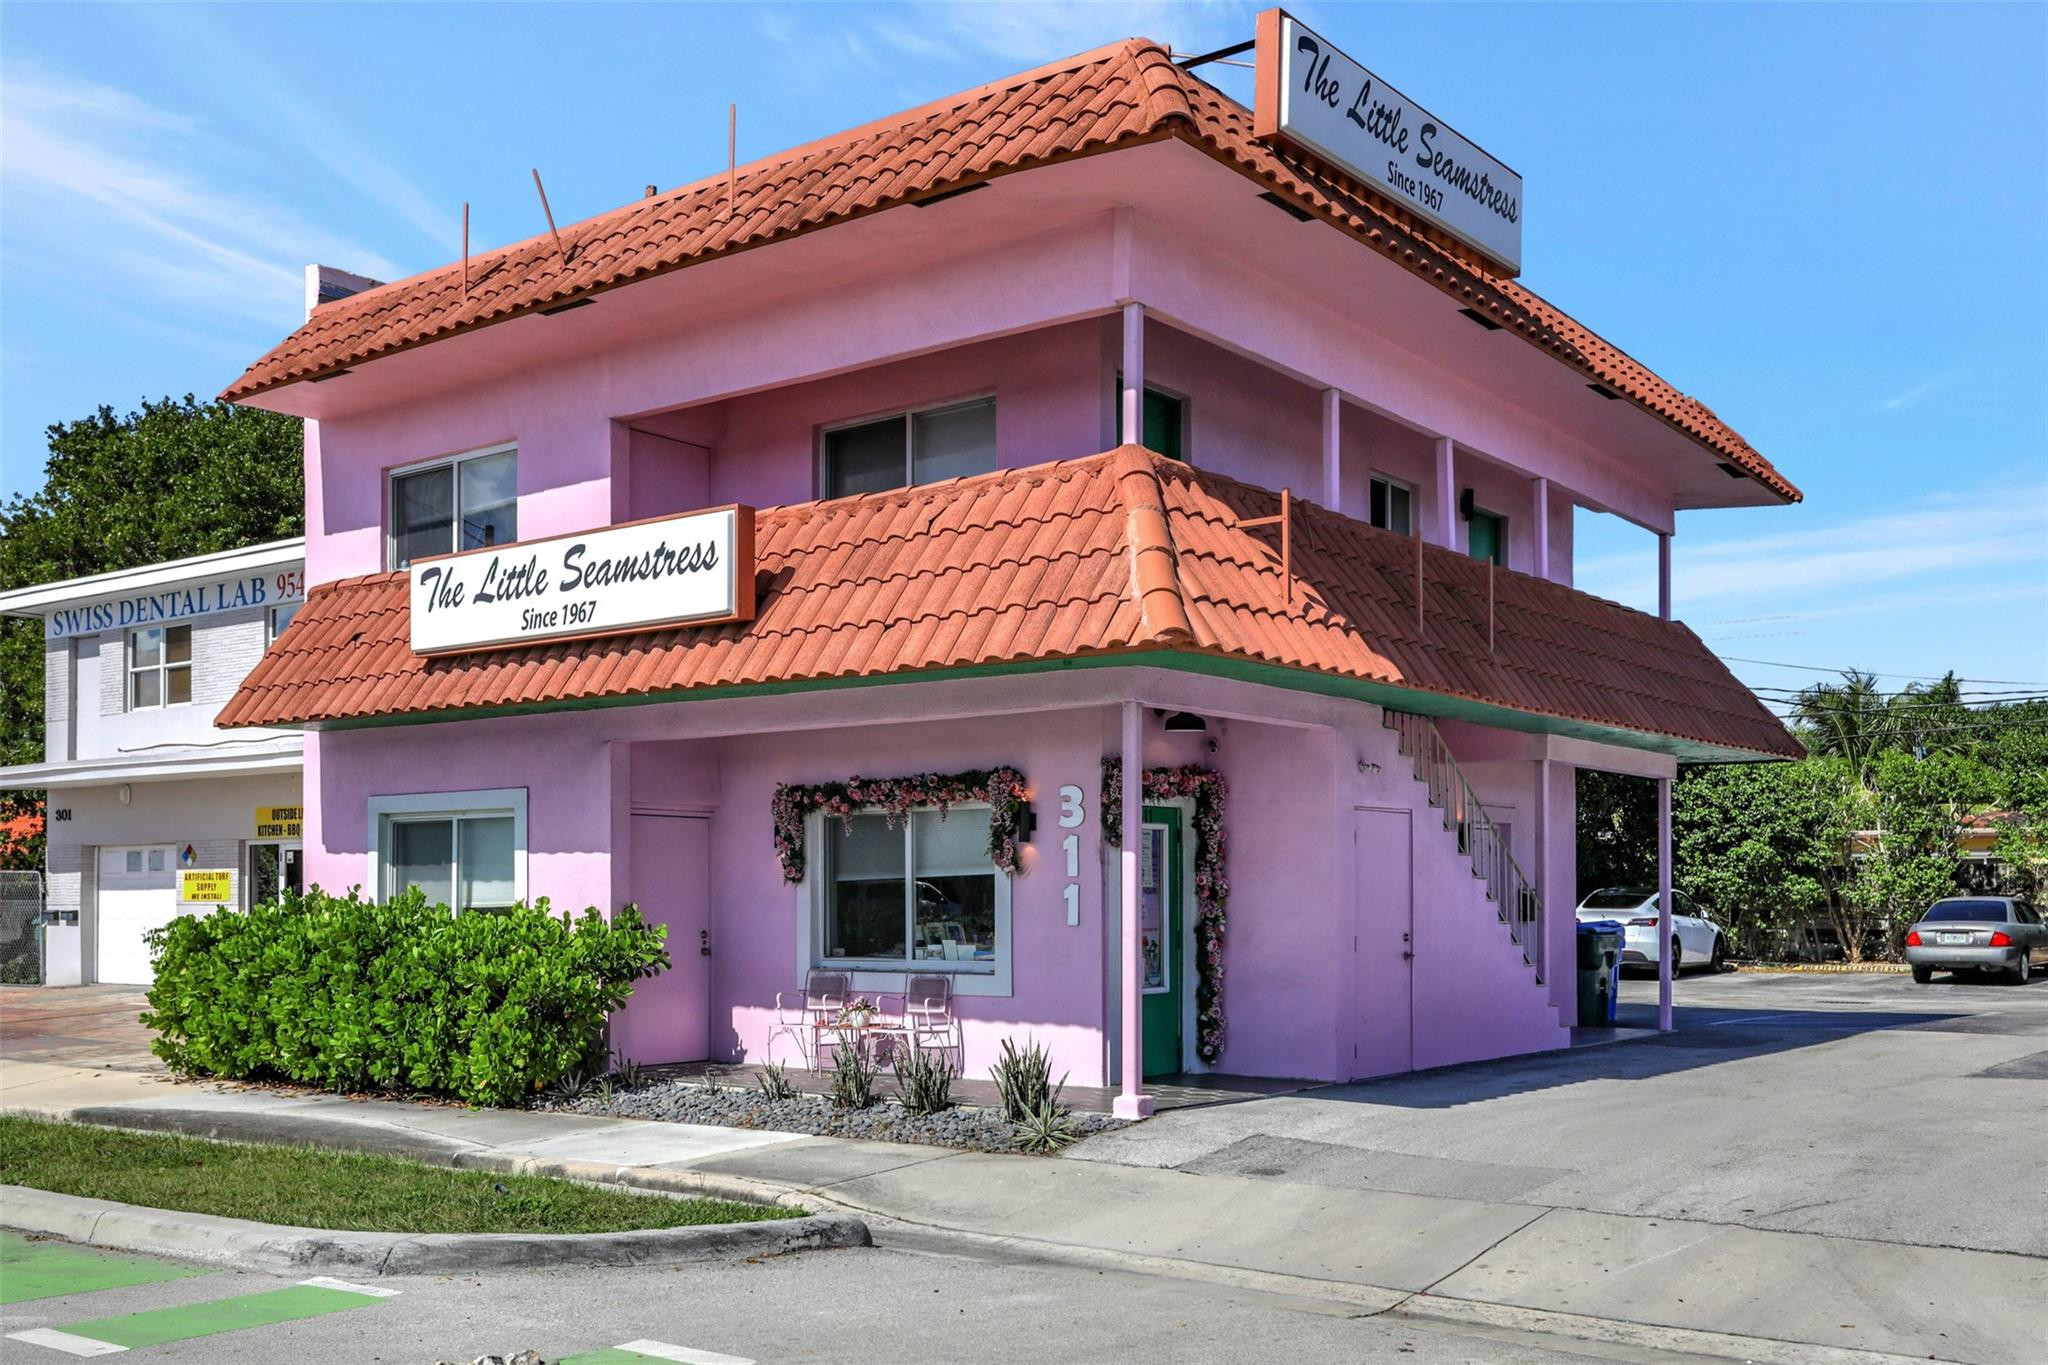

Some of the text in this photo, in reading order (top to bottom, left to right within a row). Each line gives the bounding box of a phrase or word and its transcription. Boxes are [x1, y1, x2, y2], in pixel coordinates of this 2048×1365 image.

[1297, 35, 1518, 224] The Little Seamstress
[1387, 160, 1444, 212] Since 1967
[420, 540, 719, 613] The Little Seamstress
[53, 570, 305, 636] SWISS DENTAL LAB 954
[521, 600, 597, 630] Since 1967
[55, 808, 72, 822] 301
[271, 808, 297, 821] OUTSIDE
[257, 824, 283, 837] KITCHEN
[287, 823, 301, 837] BBQ
[1058, 784, 1085, 926] 311
[184, 871, 229, 881] ARTIFICIAL TURF
[196, 882, 217, 891] SUPPLY
[201, 892, 222, 900] INSTALL
